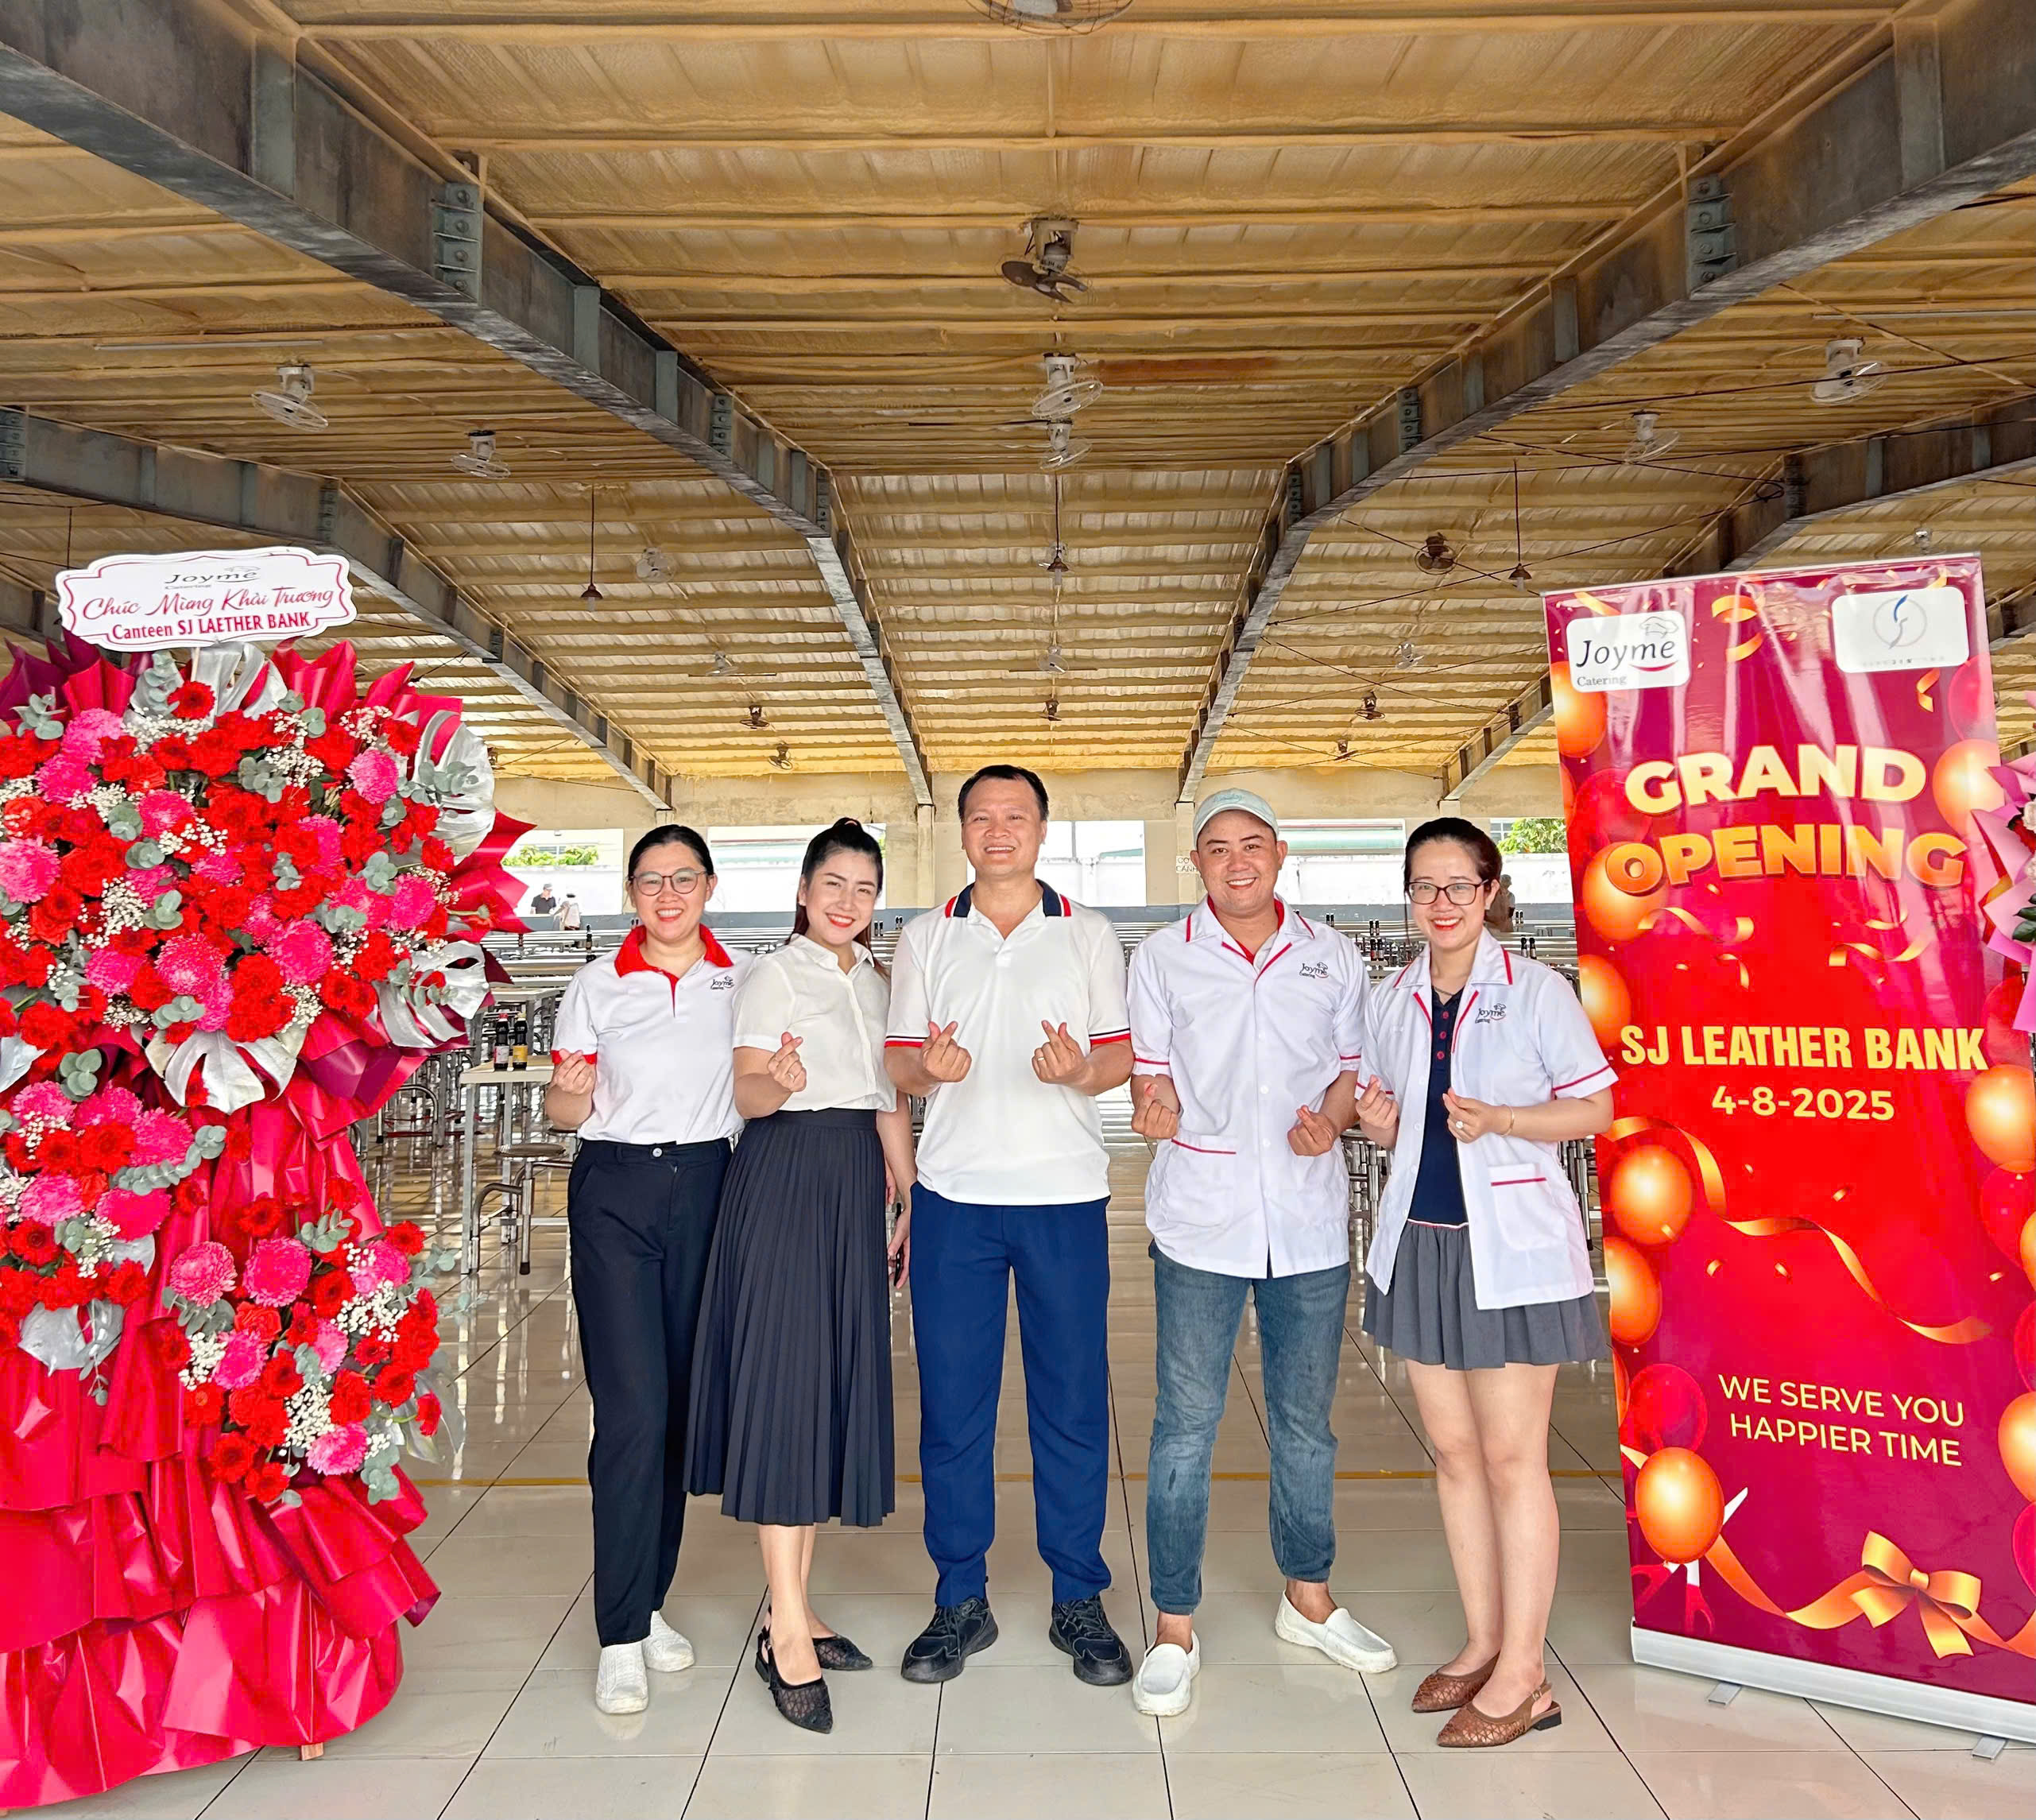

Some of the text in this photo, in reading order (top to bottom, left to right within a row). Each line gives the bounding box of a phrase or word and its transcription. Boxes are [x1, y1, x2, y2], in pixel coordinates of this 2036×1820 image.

[165, 571, 257, 584] Joyme
[83, 597, 141, 620] Chúc
[112, 611, 310, 640] Canteen SJ LAETHER BANK
[1576, 640, 1675, 671] Joyme
[1577, 676, 1628, 687] Catering
[1625, 744, 1927, 814] GRAND
[1605, 823, 1968, 894] OPENING
[1299, 962, 1327, 976] Joyme
[1476, 1008, 1504, 1020] Joyme
[1620, 1025, 1989, 1071] SJ LEATHER BANK
[1711, 1085, 1895, 1121] 4-8-2025
[1718, 1373, 1964, 1427] WE SERVE YOU
[1730, 1413, 1962, 1466] HAPPIER TIME
